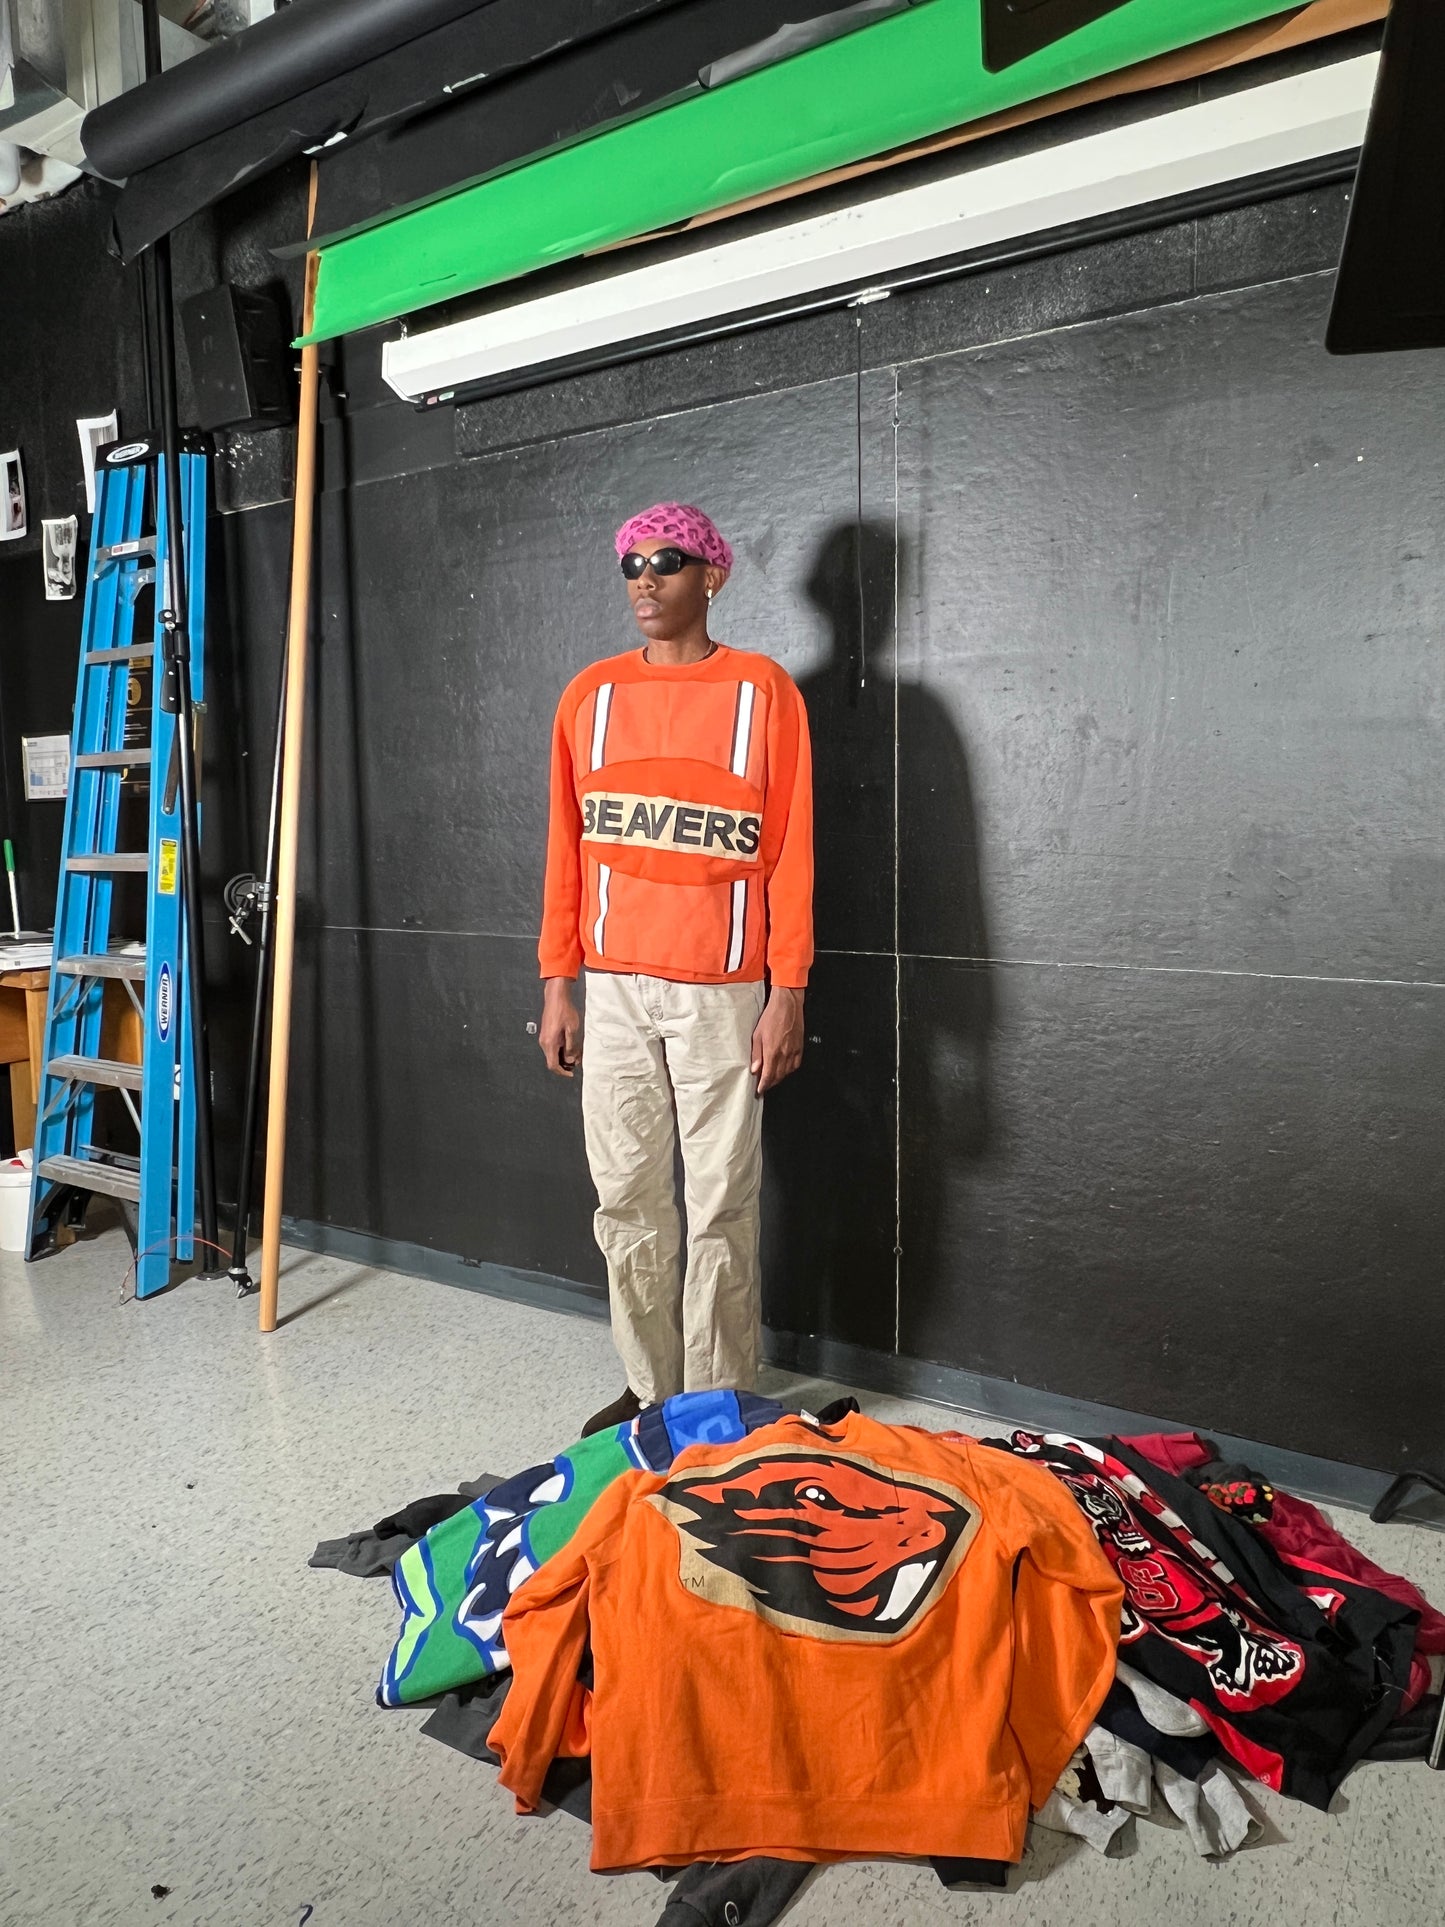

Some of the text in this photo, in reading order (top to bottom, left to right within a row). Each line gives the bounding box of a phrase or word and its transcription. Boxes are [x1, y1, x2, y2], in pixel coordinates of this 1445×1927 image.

[584, 799, 760, 855] BEAVERS
[160, 978, 168, 1025] WERNER
[682, 1575, 705, 1589] TM
